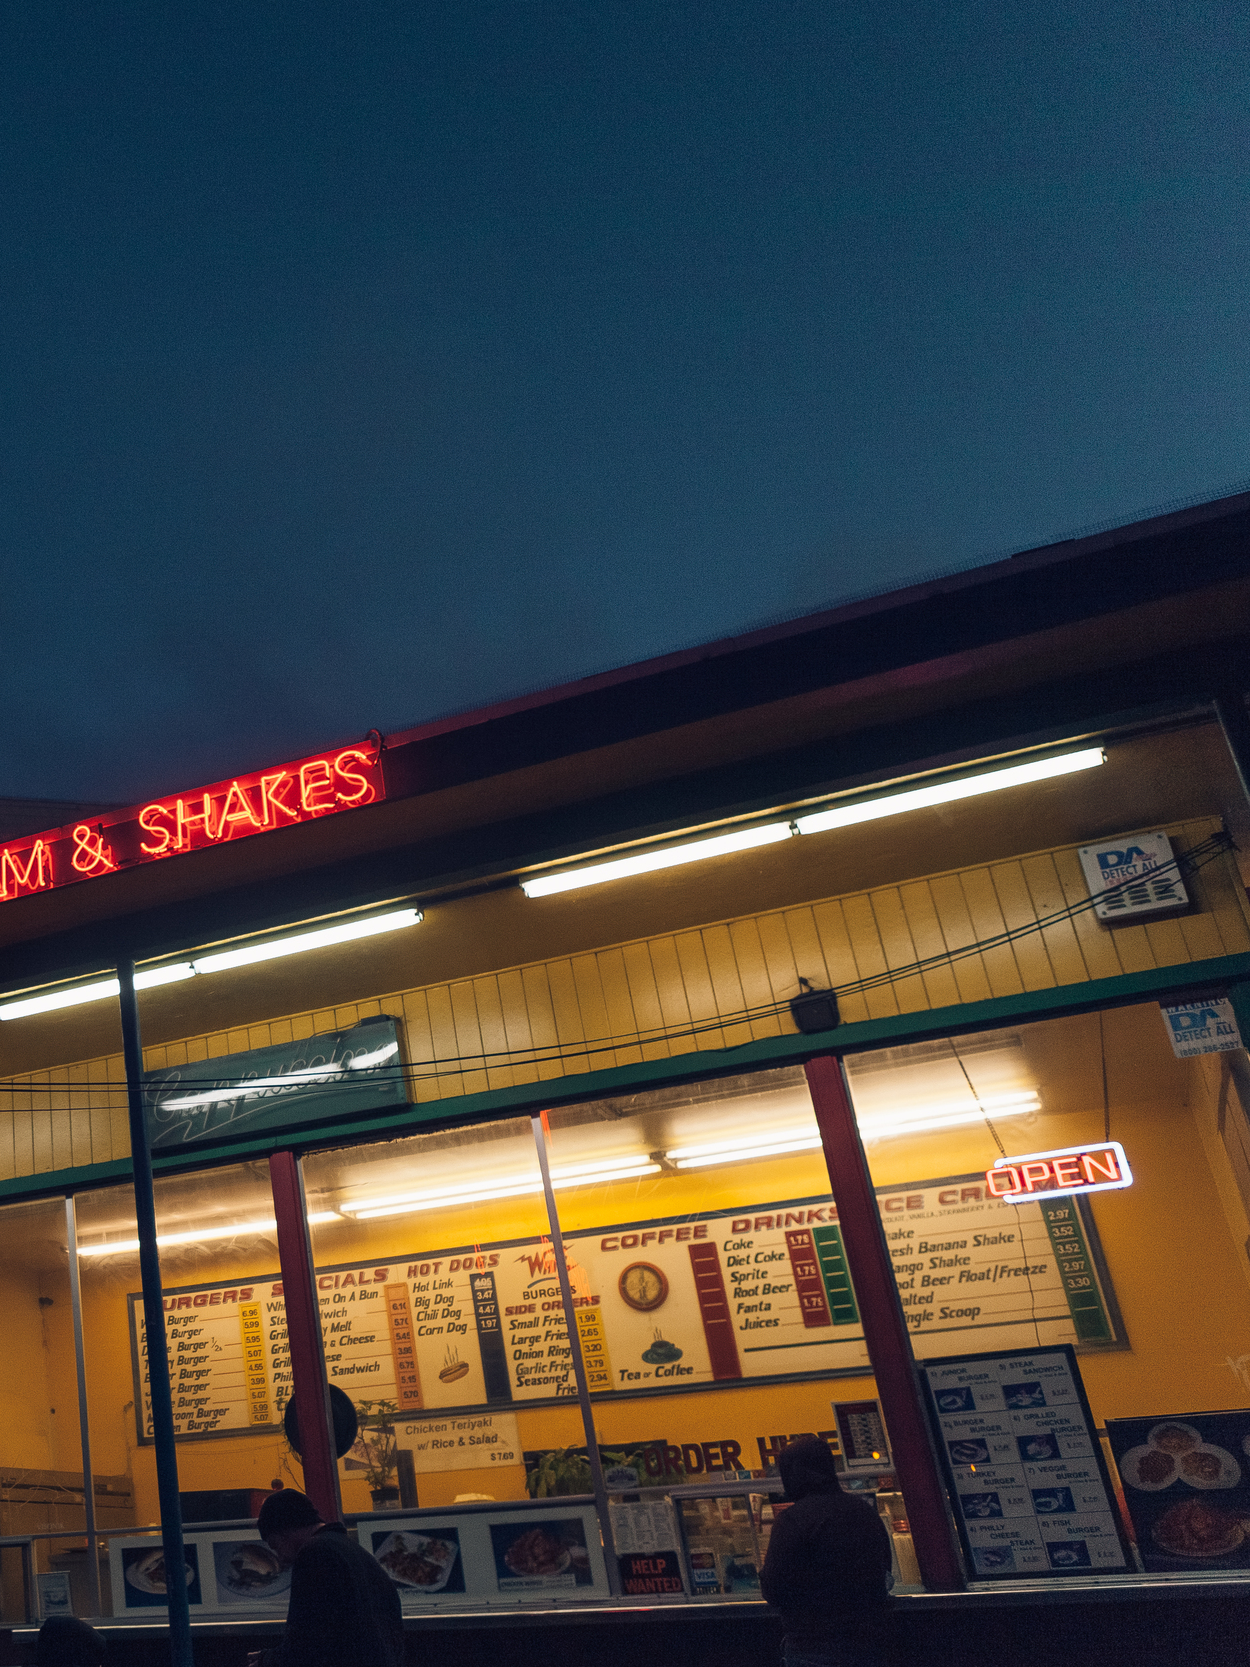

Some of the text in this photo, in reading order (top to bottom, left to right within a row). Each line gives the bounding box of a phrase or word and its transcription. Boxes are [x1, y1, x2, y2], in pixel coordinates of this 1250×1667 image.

[71, 825, 115, 873] &
[138, 750, 372, 856] SHAKES
[1096, 846, 1145, 869] DA
[1101, 860, 1159, 880] DETECT ALL
[1166, 998, 1226, 1014] WARNING
[1168, 1008, 1220, 1032] DA
[1174, 1023, 1235, 1043] DETECT ALL
[985, 1152, 1119, 1197] OPEN
[731, 1206, 839, 1235] DRINKS
[1048, 1209, 1069, 1220] 2.97
[601, 1224, 708, 1252] COFFEE
[1052, 1226, 1074, 1237] 3.52
[723, 1238, 754, 1252] Coke
[918, 1232, 1015, 1254] Banana Shake
[1057, 1243, 1080, 1254] 3.52
[727, 1251, 785, 1267] Diet Coke
[893, 1254, 971, 1276] ango Shake
[407, 1254, 500, 1279] HOT DOGS
[1063, 1261, 1085, 1271] 2.97
[730, 1268, 768, 1285] Sprite
[921, 1263, 1047, 1288] Beer Float/Freeze
[271, 1268, 389, 1298] SCIALS
[412, 1278, 454, 1293] Hot Link
[1068, 1277, 1090, 1288] 3.30
[332, 1293, 346, 1304] On
[349, 1291, 356, 1301] A
[359, 1289, 379, 1301] Bun
[476, 1290, 493, 1300] 3.47
[523, 1285, 577, 1300] BURGES
[734, 1283, 793, 1298] Root Beer
[162, 1287, 254, 1311] URGERS
[414, 1293, 454, 1309] Big Dog
[901, 1291, 934, 1306] alted
[478, 1305, 495, 1314] 4.47
[505, 1295, 601, 1316] SIDE ORERS
[737, 1301, 772, 1315] Fanta
[242, 1308, 258, 1318] 6.96
[417, 1307, 462, 1322] Chili Dog
[578, 1314, 596, 1323] 1.99
[904, 1306, 981, 1328] ingle Scoop
[167, 1314, 199, 1327] Burger
[244, 1320, 260, 1329] 5.99
[330, 1321, 352, 1333] Melt
[481, 1319, 497, 1329] 1.97
[509, 1315, 539, 1331] Small
[739, 1317, 780, 1331] Juices
[171, 1328, 204, 1340] Burger
[418, 1322, 468, 1337] Corn Dog
[581, 1328, 599, 1337] 2.65
[246, 1335, 261, 1344] 5.95
[330, 1334, 376, 1347] & Cheese
[511, 1333, 541, 1348] Large
[177, 1341, 209, 1354] Burger
[247, 1349, 262, 1358] 5.07
[513, 1345, 572, 1361] Onion Ring
[585, 1343, 602, 1352] 3.20
[177, 1355, 209, 1367] Burger
[248, 1363, 263, 1372] 4.55
[1009, 1360, 1034, 1369] STEAK
[179, 1368, 212, 1381] Burger
[331, 1361, 381, 1377] Sandwich
[516, 1362, 547, 1376] Garlic
[619, 1369, 641, 1381] Tea
[655, 1364, 694, 1378] Coffee
[941, 1368, 967, 1376] JUNIOR
[1023, 1365, 1064, 1375] SANDWICH
[250, 1377, 265, 1386] 3.99
[516, 1371, 569, 1387] Seasoned
[958, 1373, 989, 1382] BURGER
[177, 1382, 210, 1395] Burger
[251, 1391, 266, 1400] 5.07
[177, 1396, 210, 1409] Burger
[253, 1404, 268, 1412] 5.99
[196, 1407, 229, 1419] Burger
[254, 1413, 269, 1422] 5.07
[1023, 1411, 1057, 1420] GRILLED
[187, 1419, 220, 1432] Burger
[405, 1417, 493, 1436] Chicken Teriyaki
[969, 1425, 1002, 1433] BURGER
[1036, 1418, 1071, 1427] CHICKEN
[1050, 1425, 1084, 1434] BURGER
[417, 1433, 498, 1450] w/ Rice & Salad
[645, 1439, 746, 1477] ORDER
[966, 1471, 996, 1479] TURKEY
[1037, 1464, 1067, 1473] VEGGIE
[983, 1477, 1015, 1486] BURGER
[1056, 1471, 1090, 1480] BURGER
[989, 1531, 1021, 1540] CHEESE
[1067, 1526, 1101, 1534] BURGER
[1010, 1539, 1035, 1547] STEAK
[631, 1559, 667, 1576] HELP
[696, 1571, 716, 1579] VISA
[624, 1576, 682, 1595] WANTED
